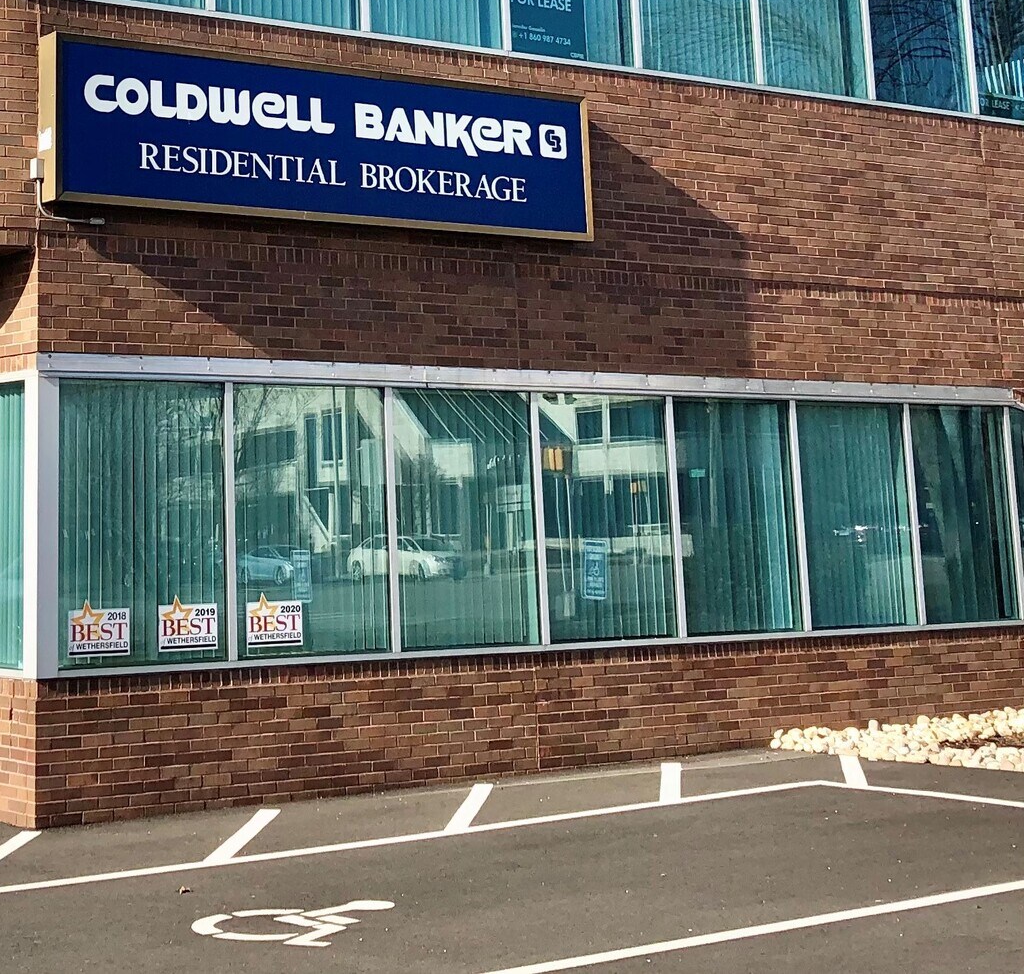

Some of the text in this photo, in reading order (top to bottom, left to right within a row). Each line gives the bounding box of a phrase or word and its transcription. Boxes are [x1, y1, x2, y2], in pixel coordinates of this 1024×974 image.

[529, 33, 541, 42] 860
[542, 34, 554, 44] 987
[555, 37, 571, 46] 4734
[979, 97, 1011, 111] OR LEASE
[84, 74, 335, 135] COLDWELL
[355, 102, 533, 158] BANKER
[139, 142, 527, 204] RESIDENTIAL BROKERAGE
[194, 608, 216, 616] 2019
[280, 605, 301, 613] 2020
[107, 611, 127, 621] 2018
[161, 618, 216, 637] BEST
[249, 614, 301, 633] BEST
[70, 622, 128, 642] BEST
[254, 631, 302, 640] WETHERSFIELD
[76, 641, 129, 650] WETHERSFIELD
[166, 636, 217, 645] WETHERSFIELD
